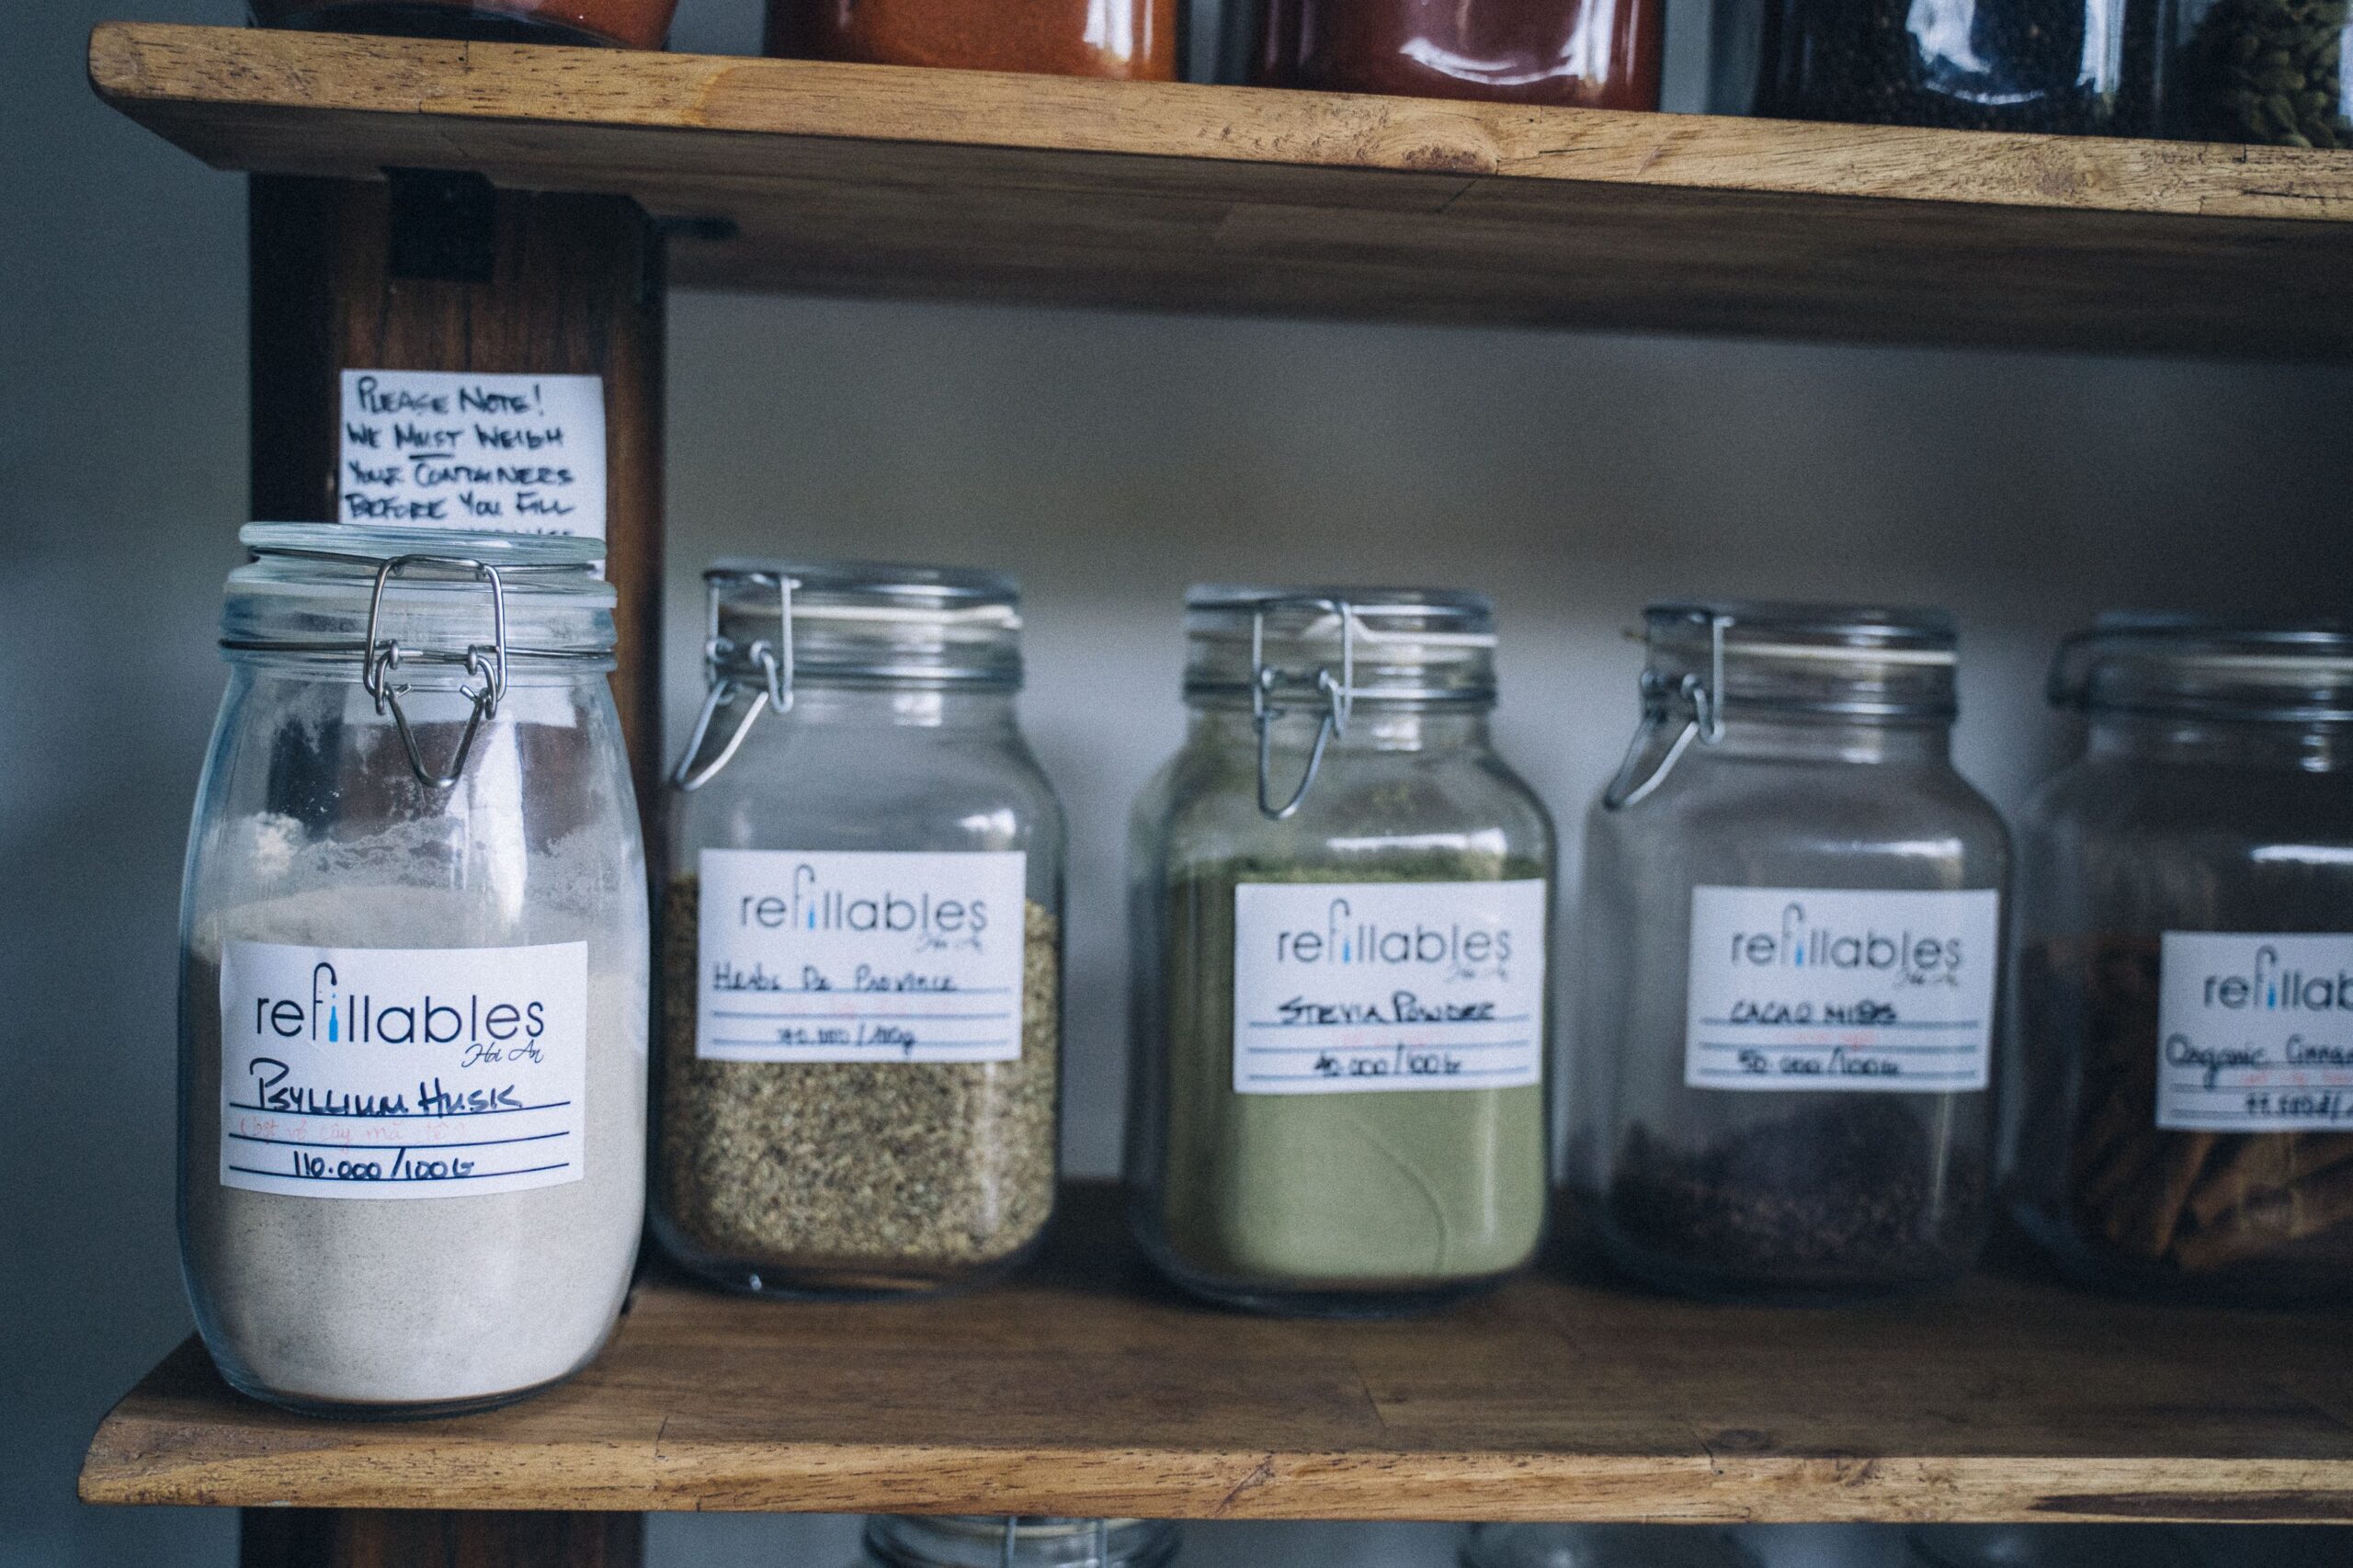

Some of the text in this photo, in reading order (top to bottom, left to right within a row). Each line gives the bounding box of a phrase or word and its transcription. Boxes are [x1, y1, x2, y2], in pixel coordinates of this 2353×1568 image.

[357, 375, 545, 415] PLEASE NOTE!
[347, 423, 565, 449] WE MUST WEIGH
[345, 493, 448, 520] BEFORE
[741, 862, 989, 933] refillables
[1277, 897, 1512, 965] refillables
[1730, 902, 1964, 969] refillables
[256, 961, 545, 1044] refillables
